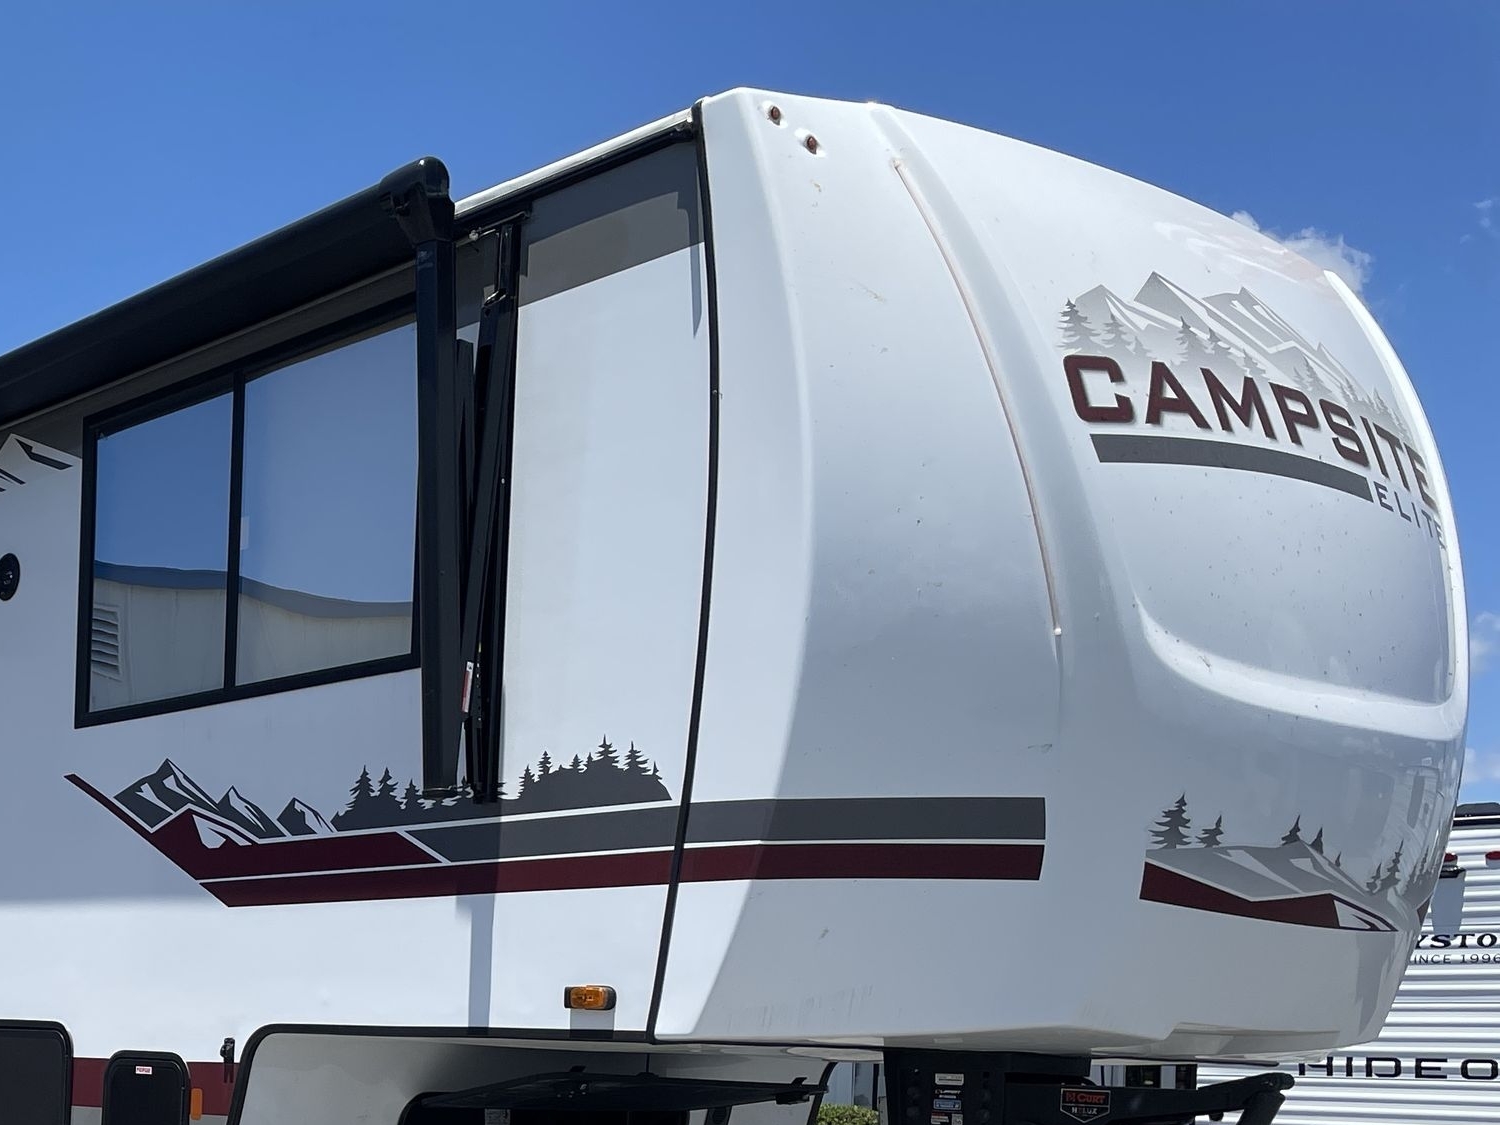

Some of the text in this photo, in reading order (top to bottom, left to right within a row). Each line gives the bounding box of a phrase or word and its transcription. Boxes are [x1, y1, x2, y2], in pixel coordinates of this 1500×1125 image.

[1063, 354, 1439, 512] CAMPSITE
[1373, 480, 1445, 550] ELITE
[1077, 1093, 1106, 1104] CURT
